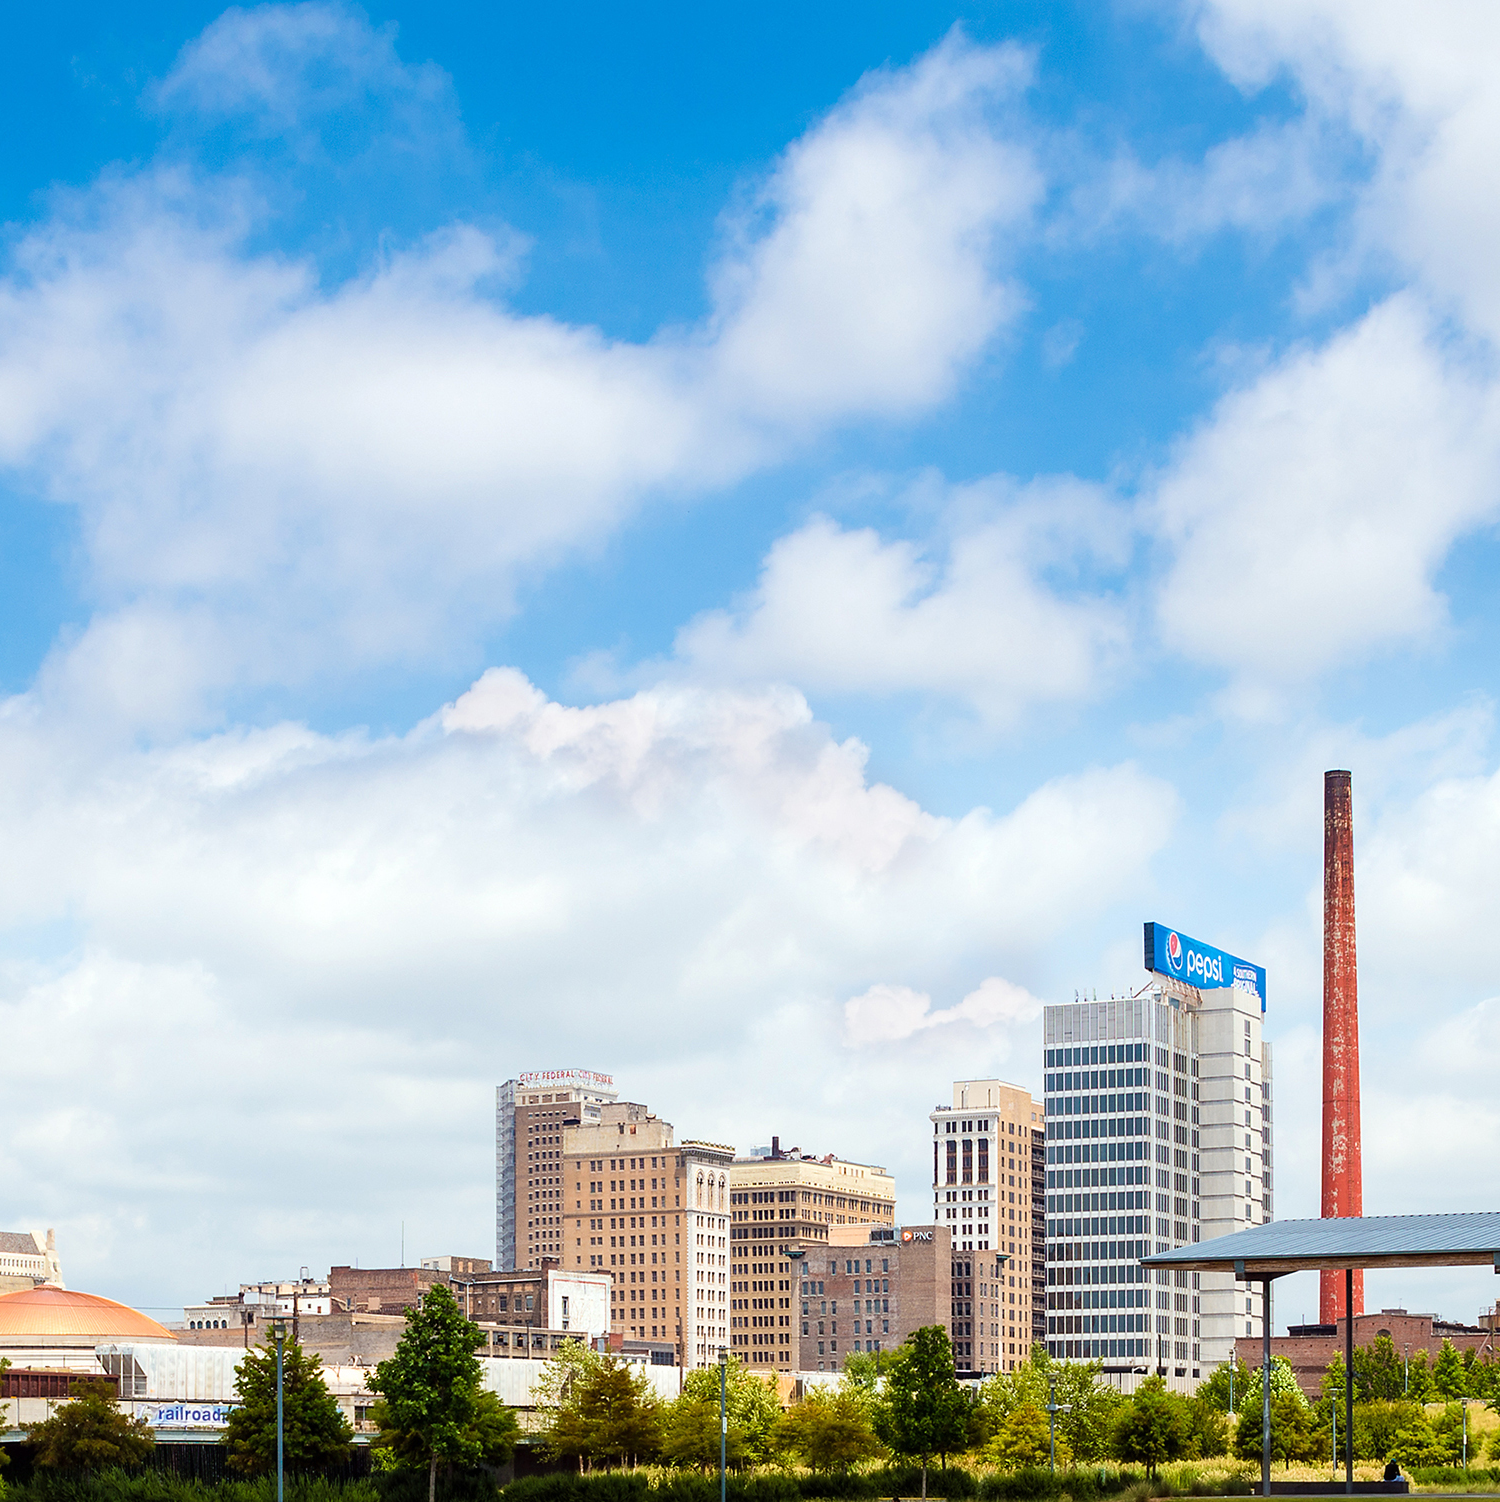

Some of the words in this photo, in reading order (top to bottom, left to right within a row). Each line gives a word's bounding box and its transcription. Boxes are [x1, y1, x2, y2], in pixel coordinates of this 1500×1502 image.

[1187, 950, 1222, 983] pepsi
[520, 1073, 540, 1082] CITY
[542, 1070, 575, 1080] FEDERAL
[579, 1070, 591, 1080] CITY
[593, 1073, 614, 1085] FEDERAL
[913, 1231, 933, 1241] PNC
